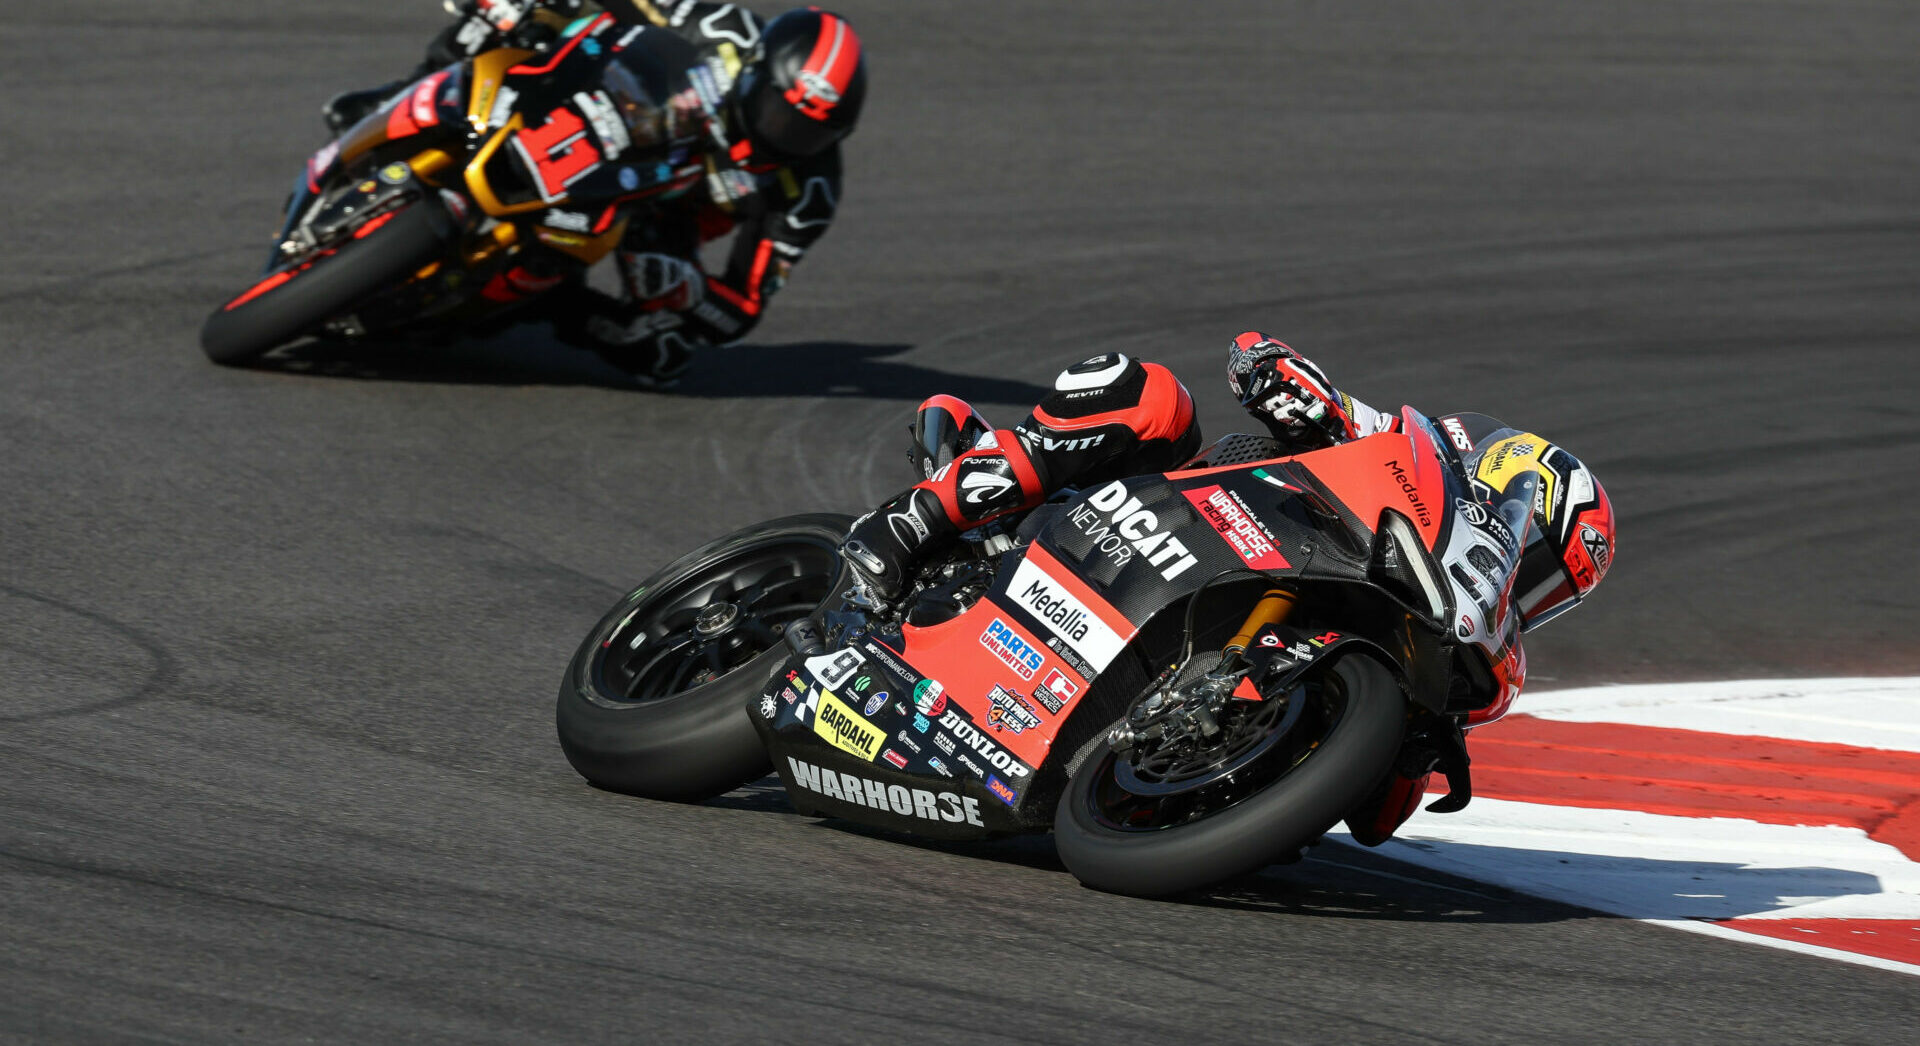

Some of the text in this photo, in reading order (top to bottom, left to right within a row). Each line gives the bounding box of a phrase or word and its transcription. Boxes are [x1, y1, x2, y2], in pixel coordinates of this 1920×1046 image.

[1066, 389, 1104, 399] REV'IT!
[1443, 418, 1474, 451] WRS
[1384, 459, 1430, 528] Medallia
[1199, 500, 1231, 533] racing
[1208, 489, 1274, 558] WARHORSE
[1226, 530, 1249, 554] HSBK
[1021, 580, 1089, 643] Medallia
[981, 633, 1033, 679] UNLIMITED
[988, 620, 1043, 670] PARTS
[821, 651, 859, 684] 9
[1076, 661, 1094, 679] Group
[917, 684, 944, 709] FERRACCI
[988, 685, 1015, 709] AUTO
[1011, 700, 1039, 728] PARTS
[1034, 690, 1059, 713] WERKES
[820, 703, 874, 755] BARDAHL
[989, 708, 1004, 722] 4
[1001, 711, 1024, 732] LESS
[939, 709, 1029, 777] DUNLOP
[787, 756, 985, 828] WARHORSE
